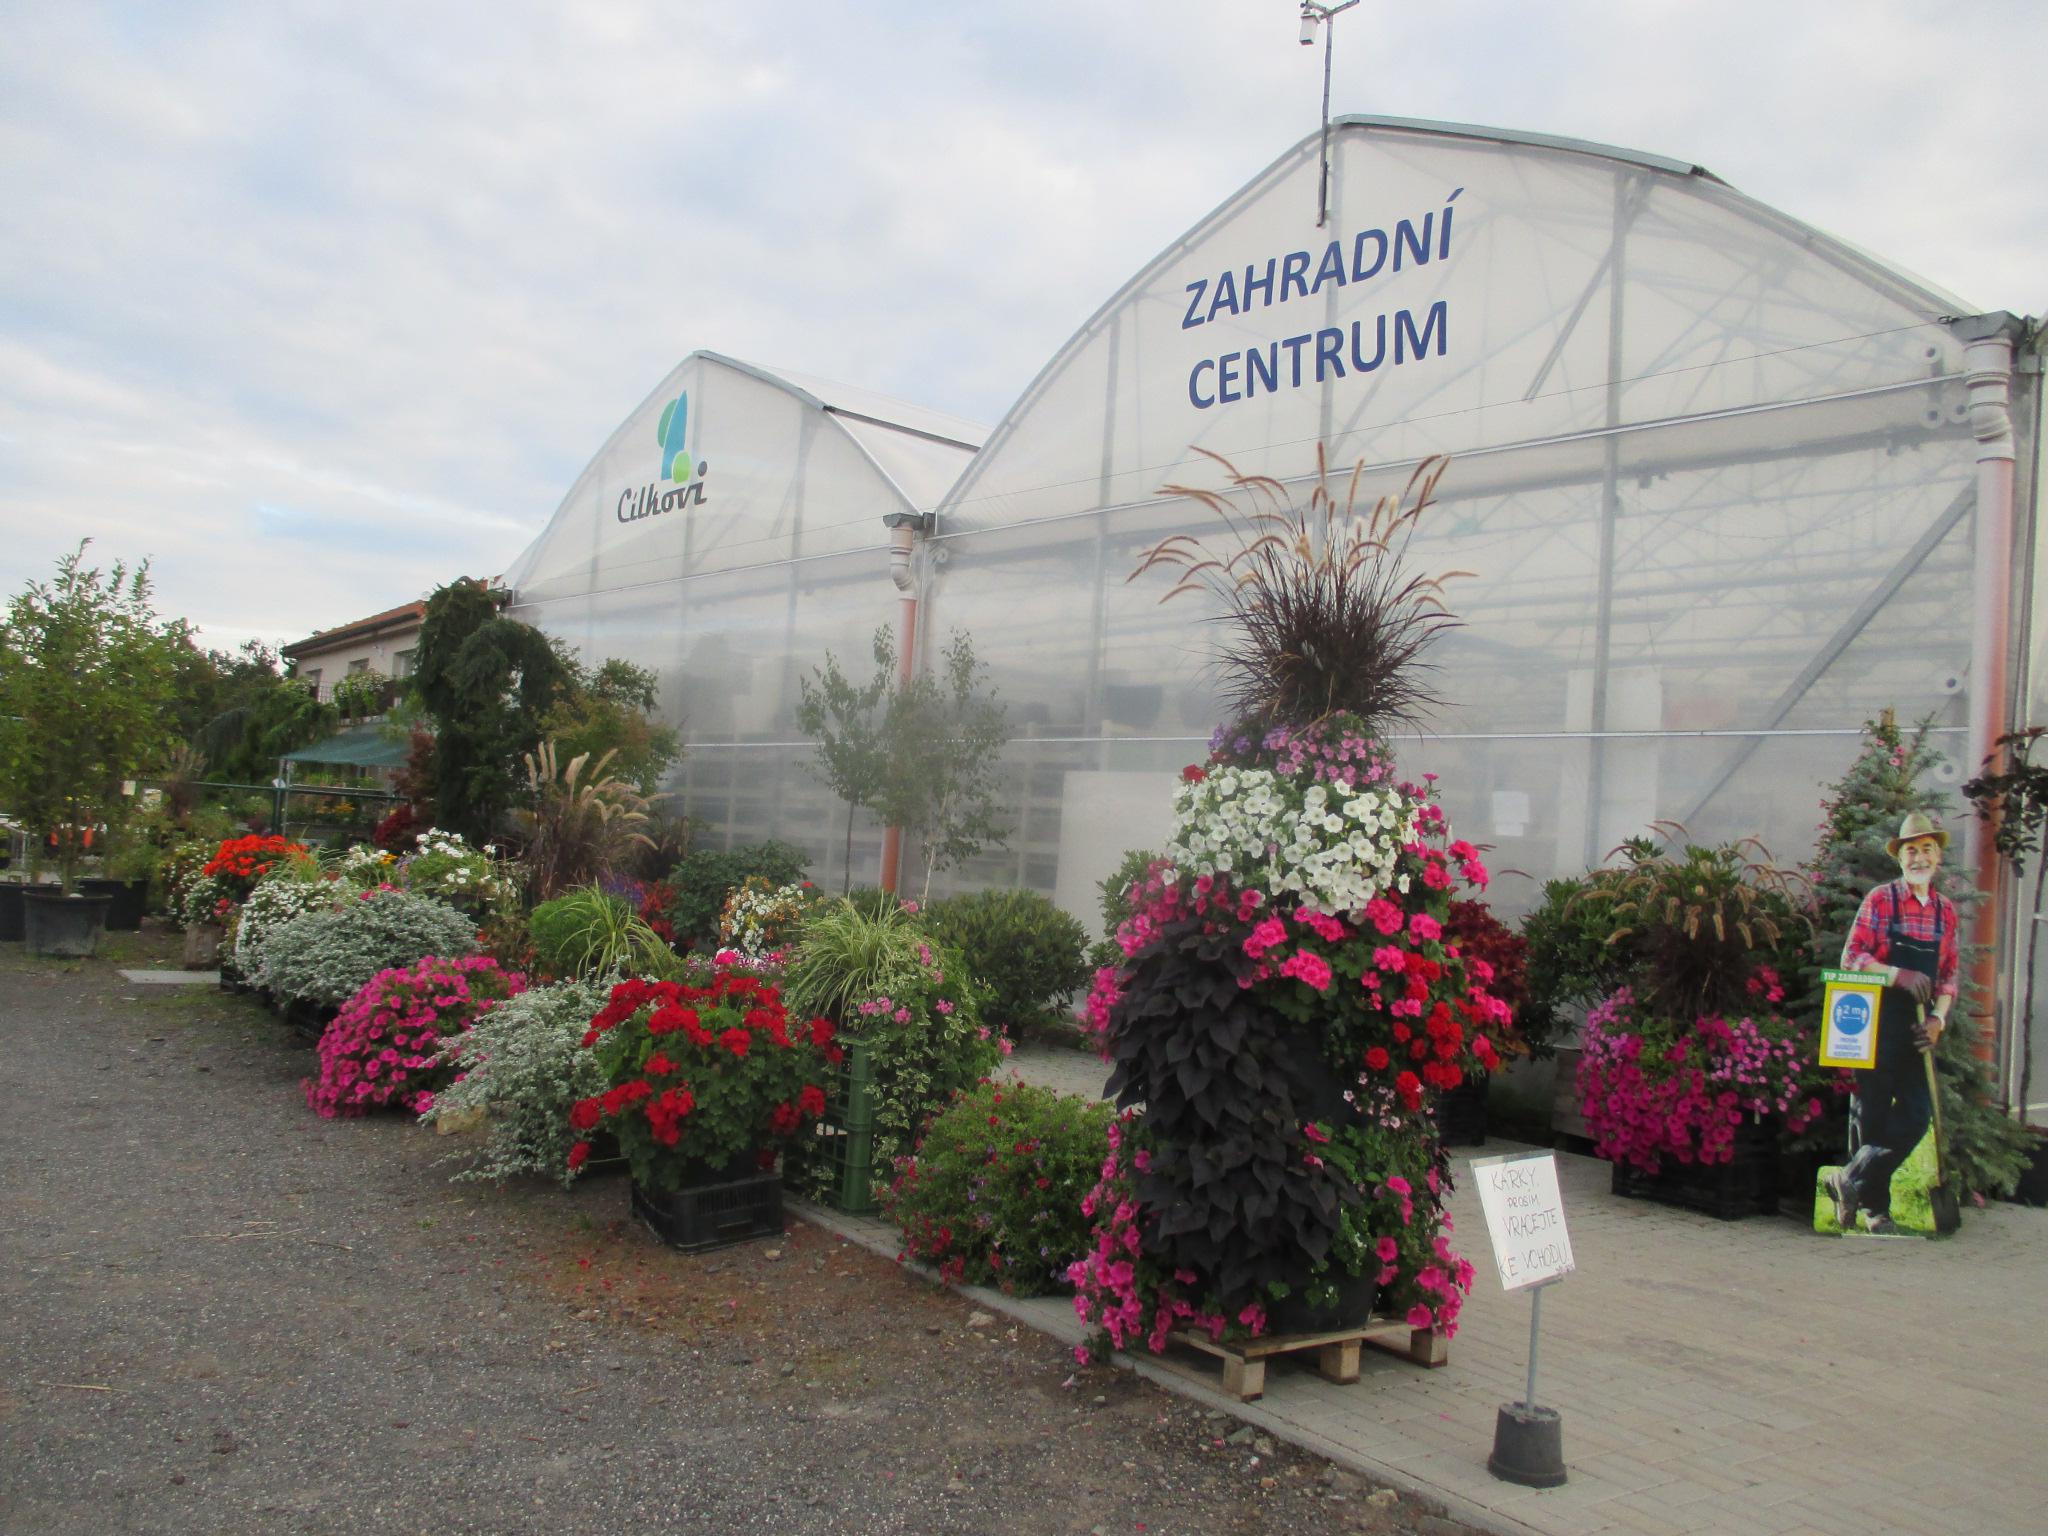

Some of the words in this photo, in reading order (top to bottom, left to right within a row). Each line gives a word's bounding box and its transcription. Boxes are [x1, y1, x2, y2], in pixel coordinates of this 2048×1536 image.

[1181, 187, 1464, 330] ZAHRADNÍ
[1188, 300, 1447, 410] CENTRUM
[1843, 1004, 1850, 1015] 2
[1502, 1207, 1557, 1239] VRACEJTE
[1497, 1256, 1519, 1280] KE
